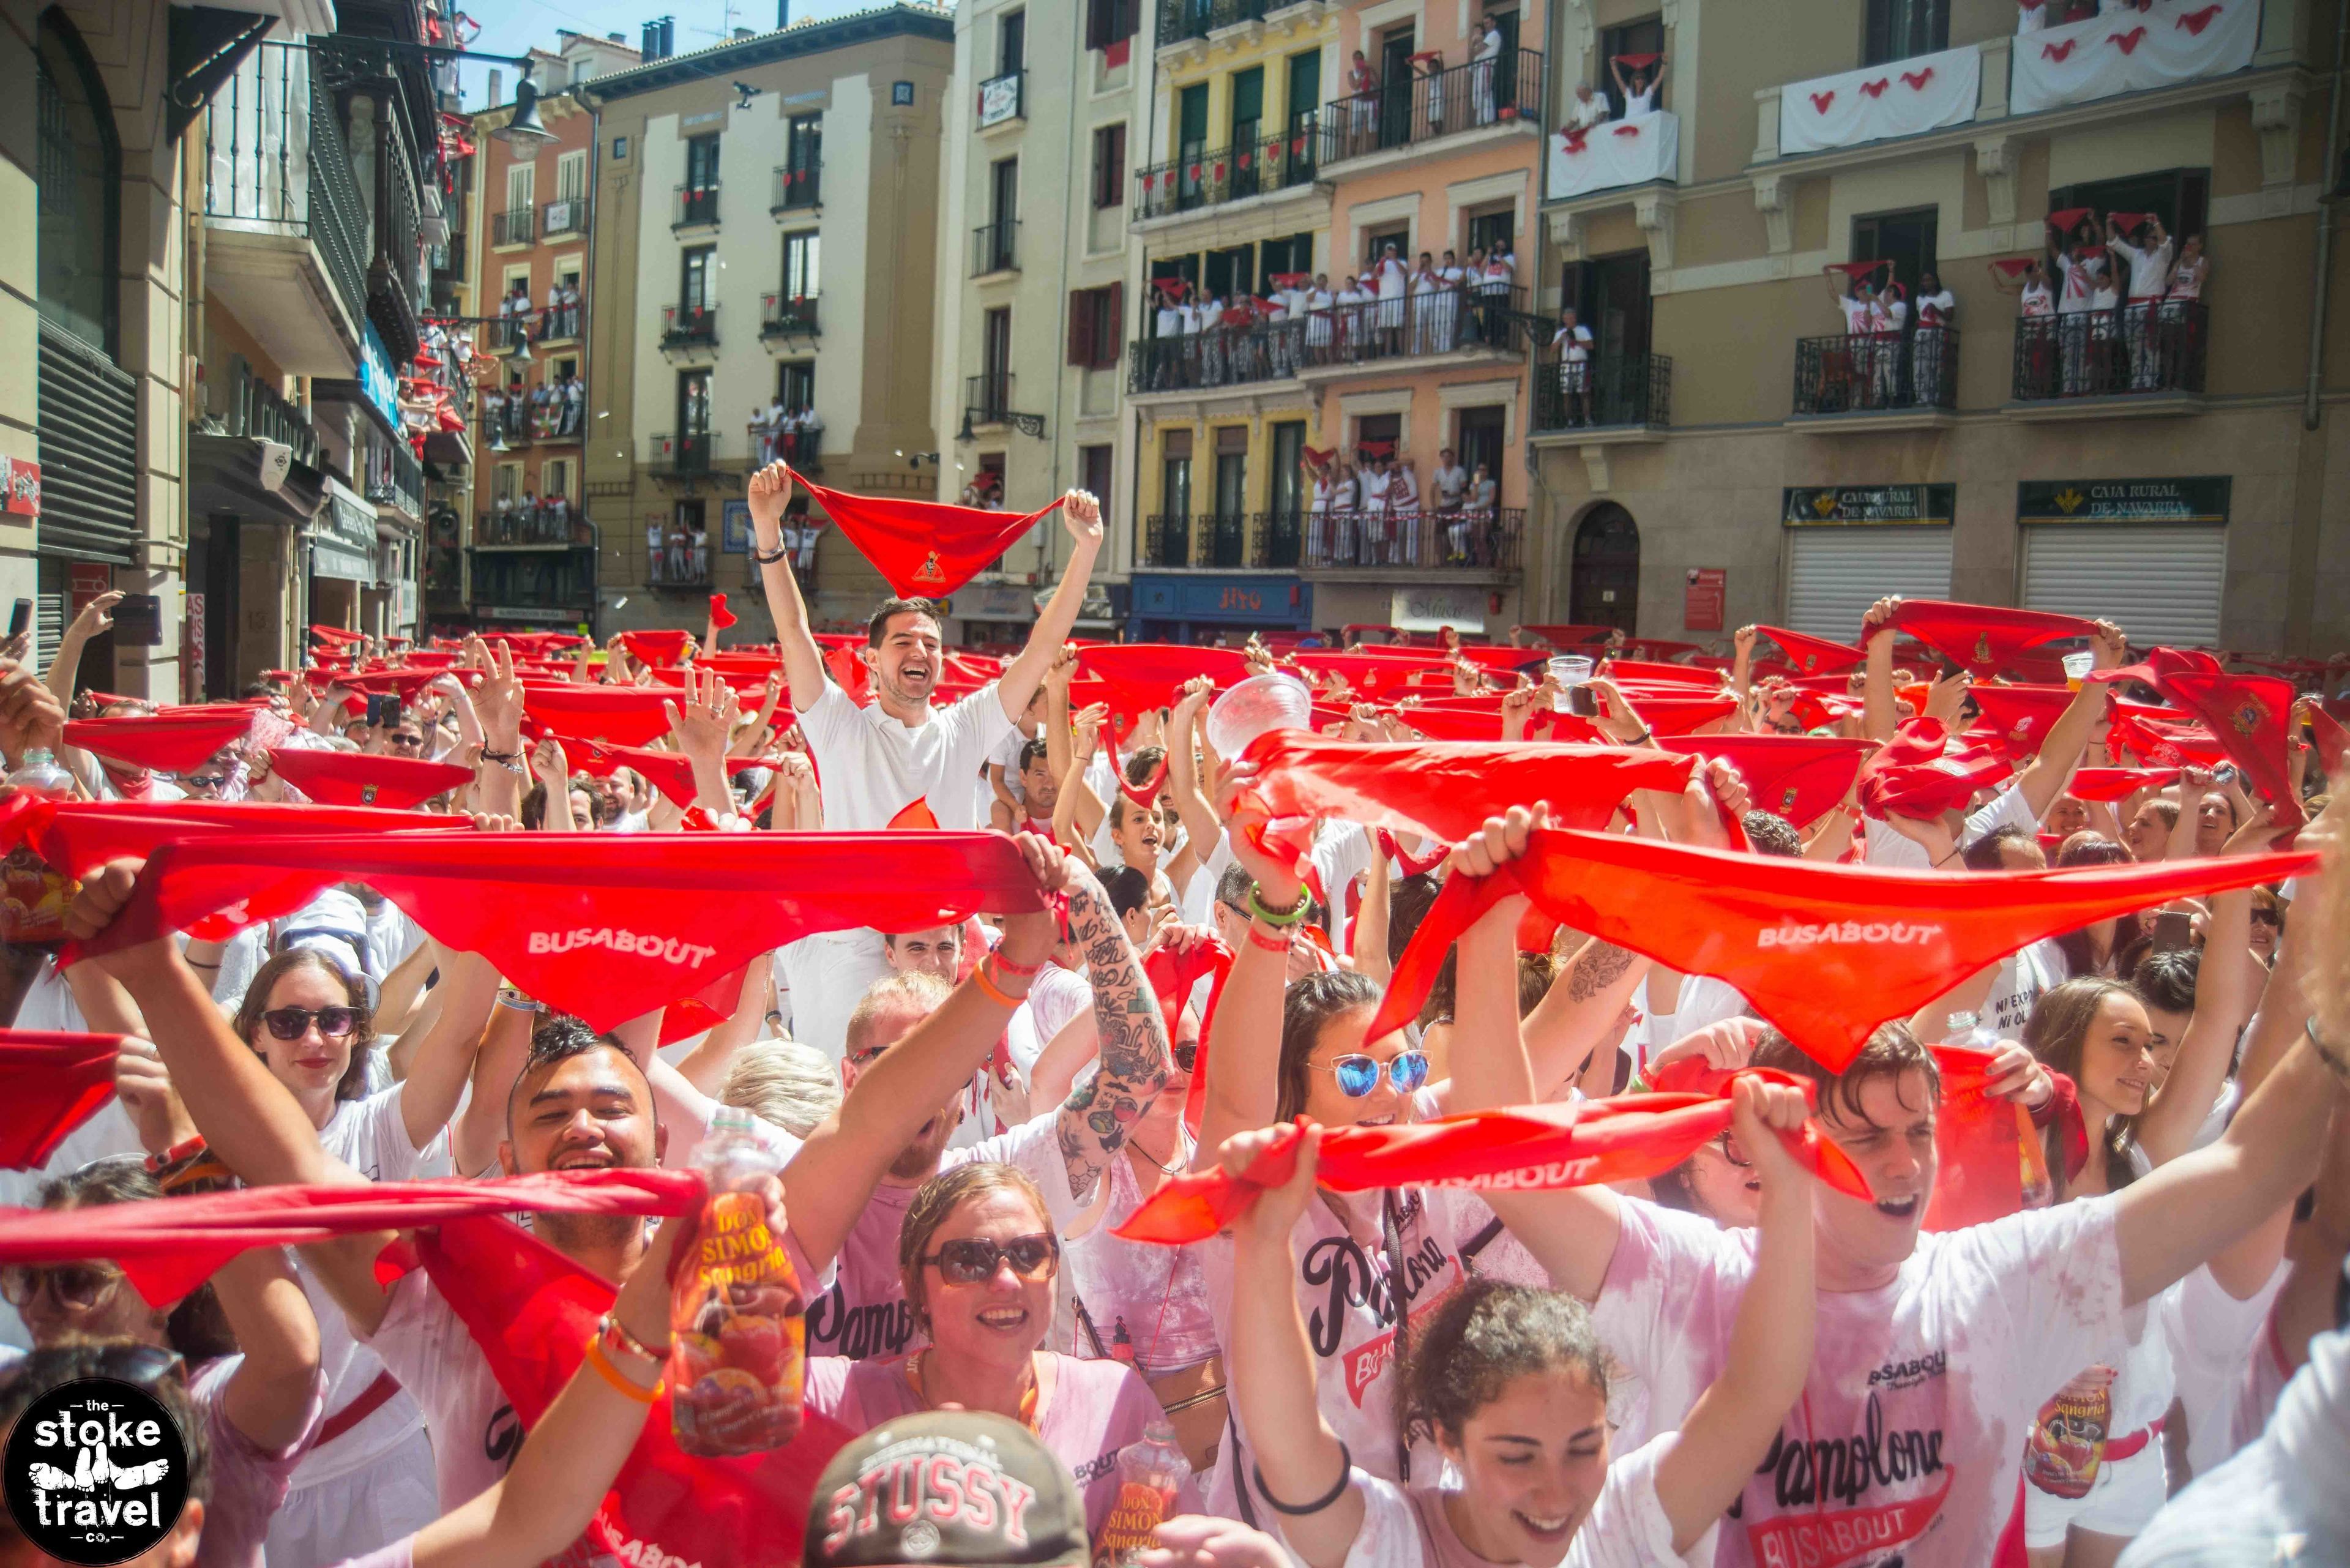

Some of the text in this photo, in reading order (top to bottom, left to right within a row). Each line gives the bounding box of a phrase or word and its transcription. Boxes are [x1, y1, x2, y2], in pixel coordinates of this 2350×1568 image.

[1842, 490, 1914, 504] CAJA RURAL
[2091, 485, 2179, 498] CAJA RURAL
[1842, 506, 1918, 518] DE NAVARRA
[2091, 501, 2185, 514] DE NAVARRA
[1757, 920, 1942, 947] BUSABOUT
[528, 927, 717, 969] BUSABOUT
[805, 1264, 914, 1361] Pamp
[2055, 1400, 2106, 1417] Sangria
[822, 1452, 1034, 1558] STUSSY
[1122, 1497, 1151, 1510] DON
